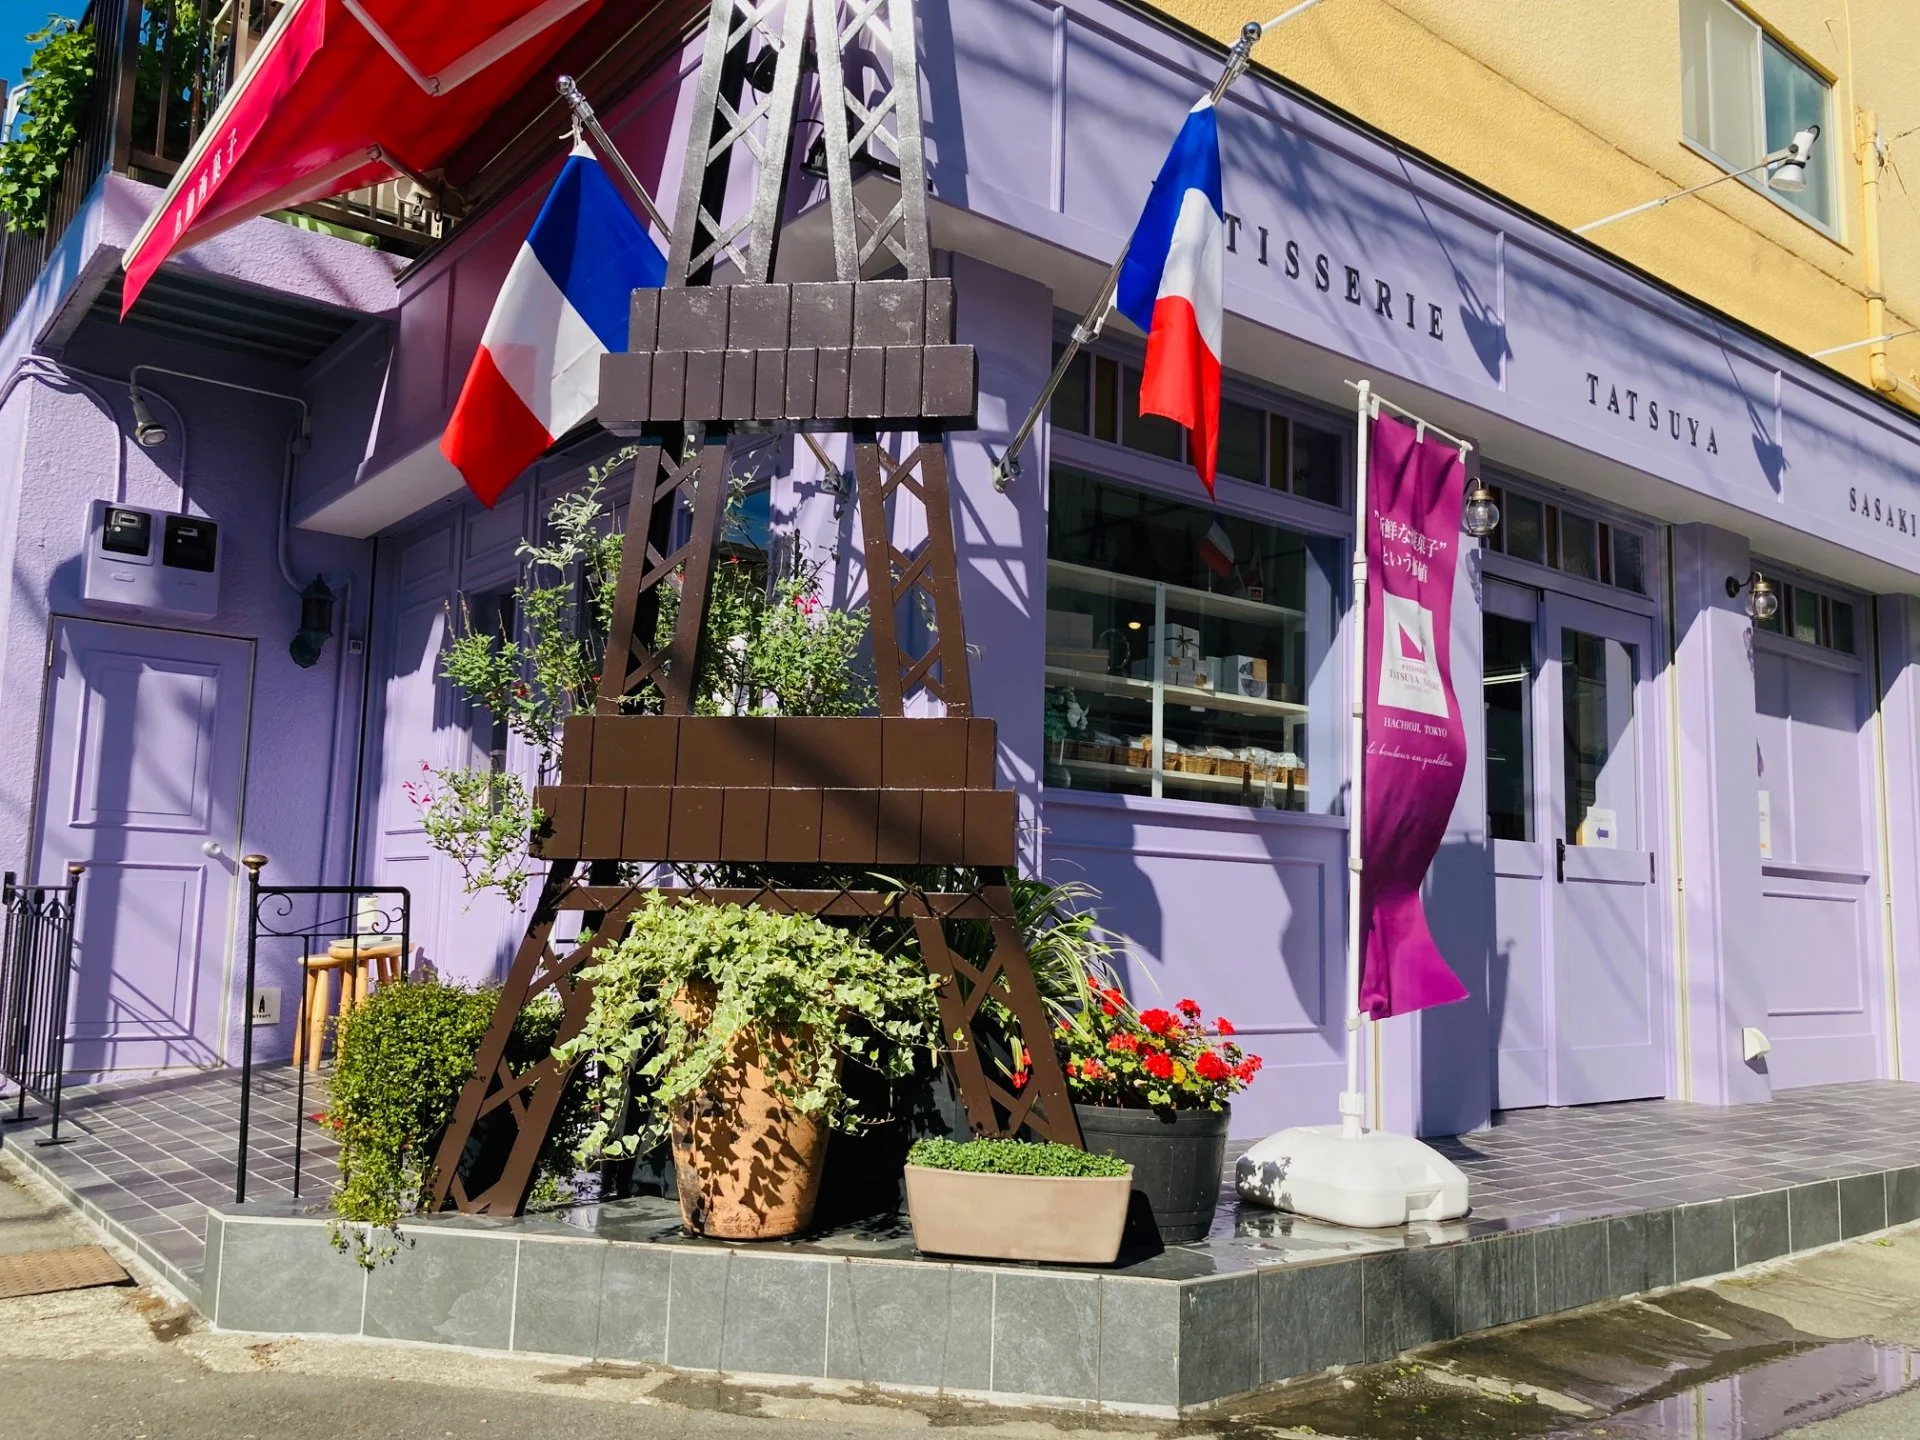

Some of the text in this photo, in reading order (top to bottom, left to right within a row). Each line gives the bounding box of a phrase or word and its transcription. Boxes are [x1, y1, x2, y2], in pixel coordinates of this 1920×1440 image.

[1224, 212, 1443, 341] TISSERIE
[1586, 372, 1718, 455] TATSUYA
[1849, 486, 1916, 537] SASAKI
[1424, 724, 1447, 738] TOKYO
